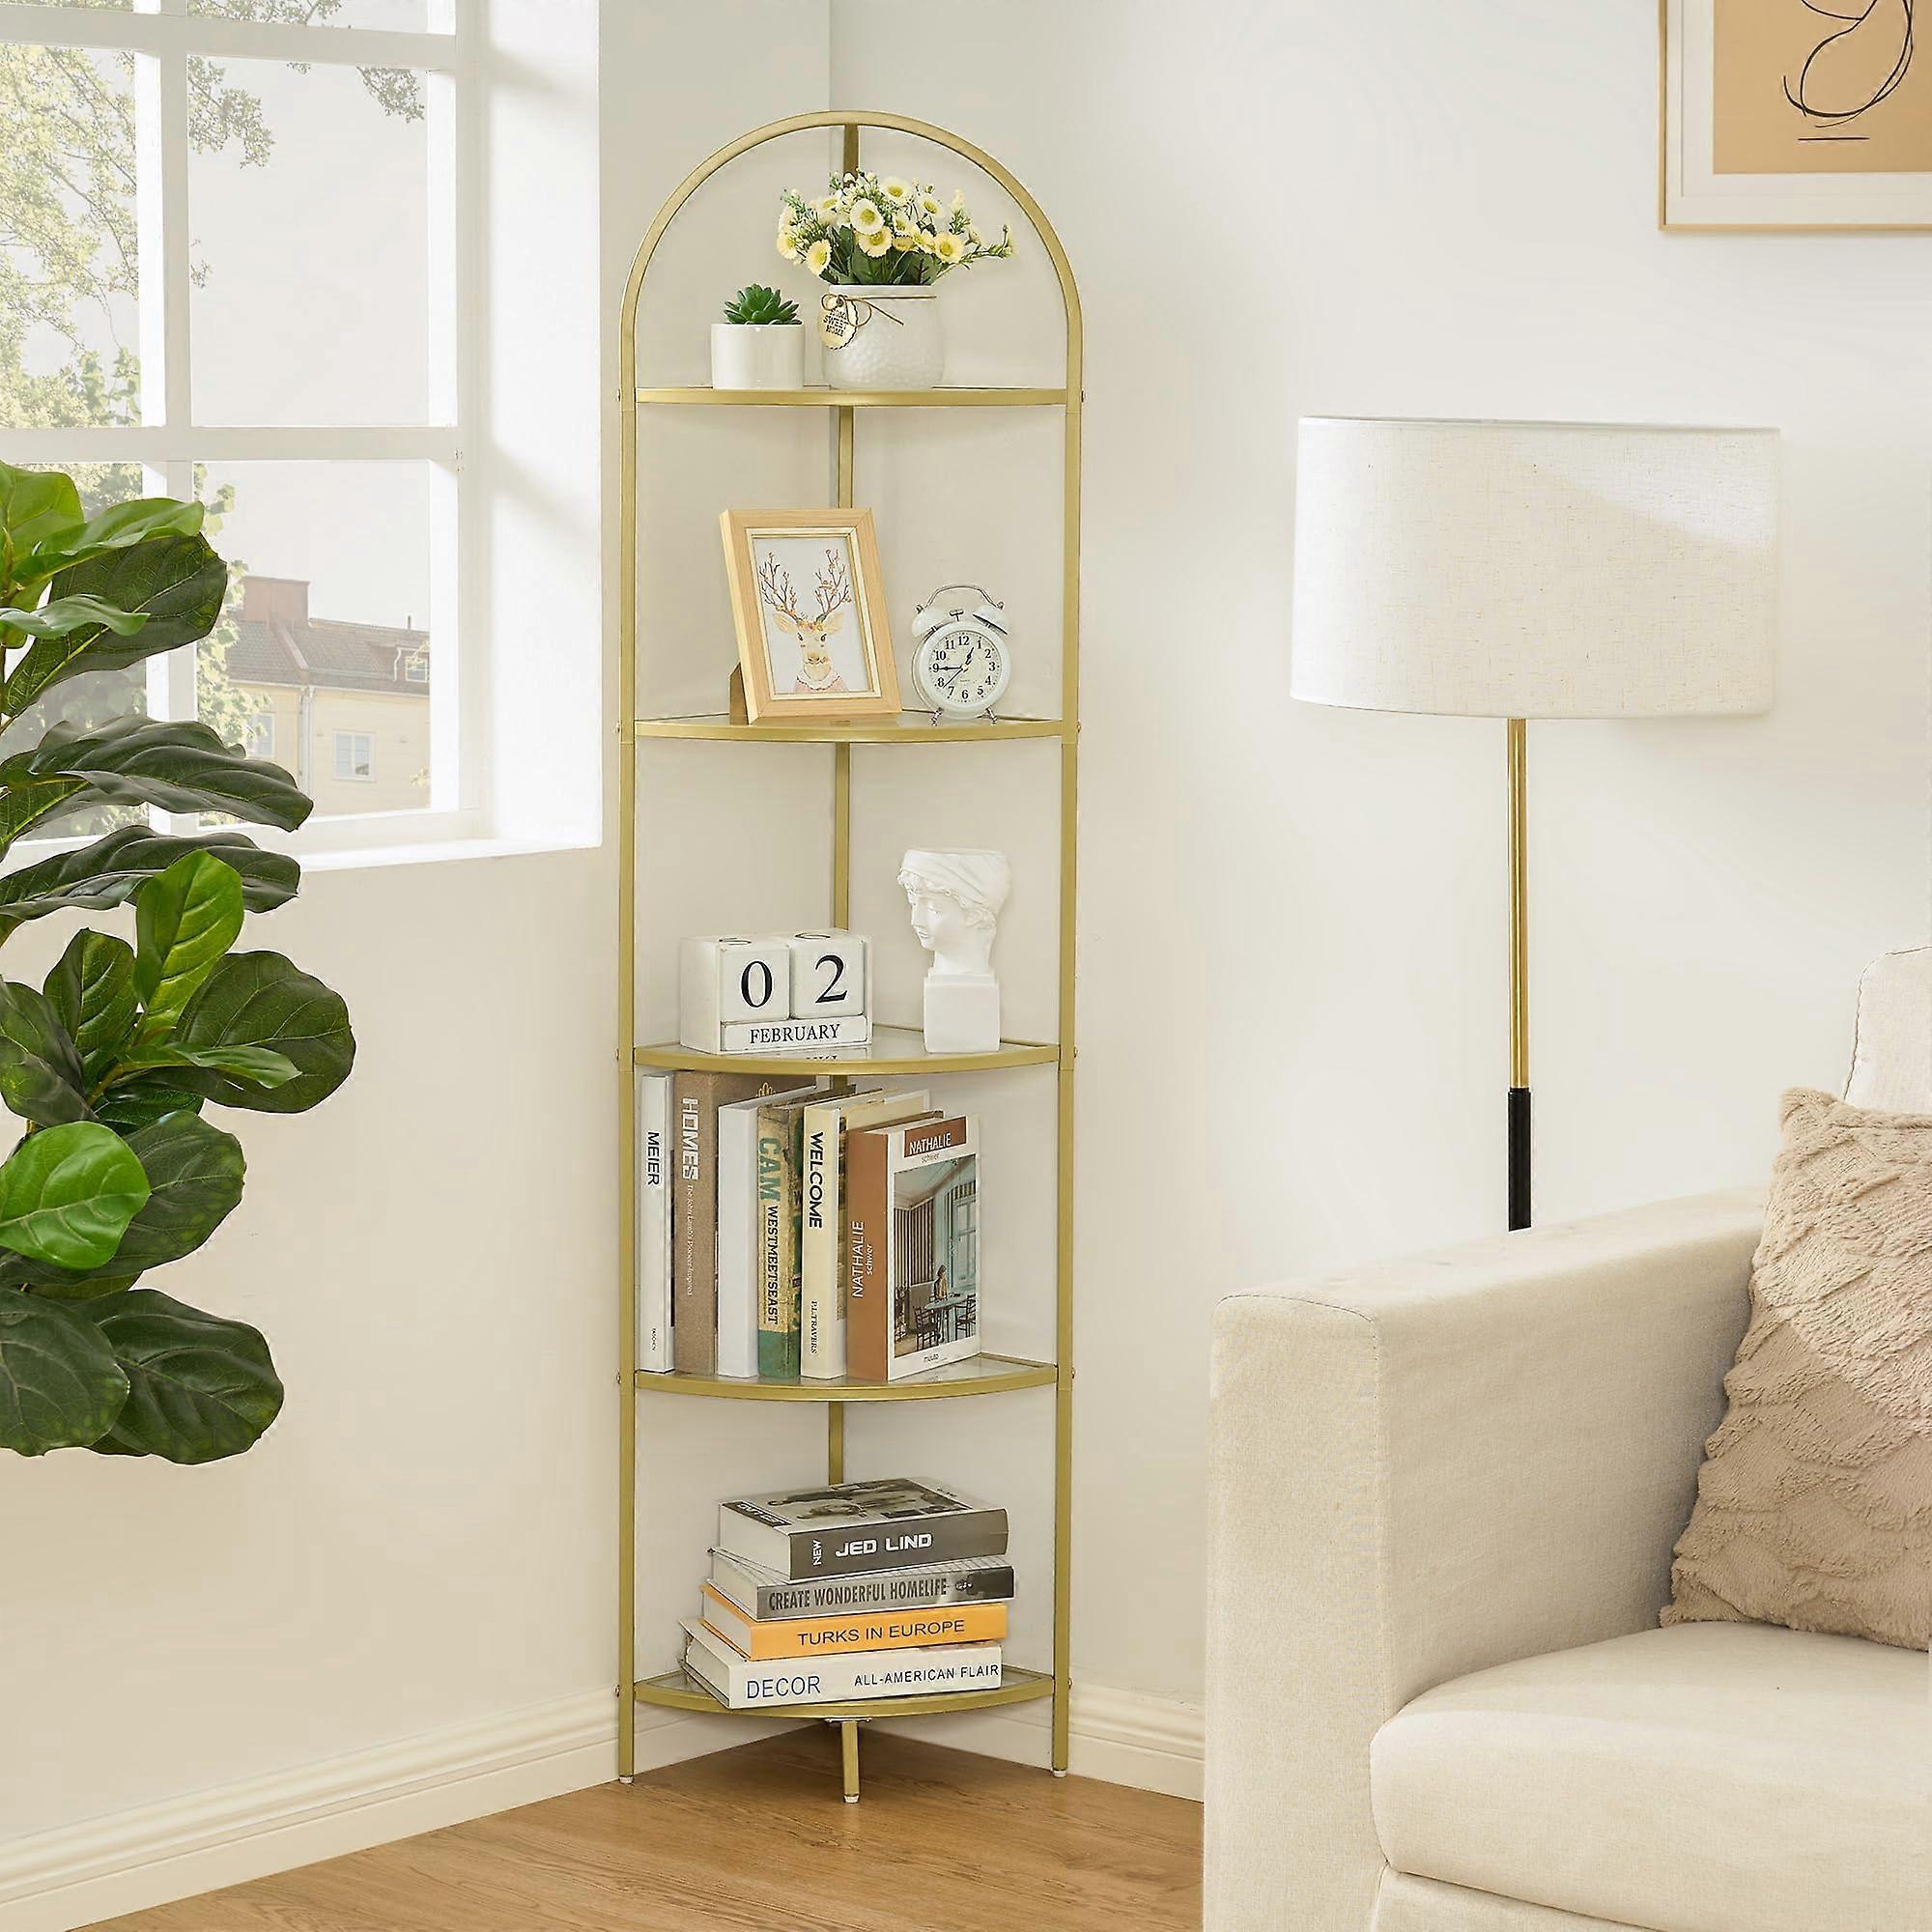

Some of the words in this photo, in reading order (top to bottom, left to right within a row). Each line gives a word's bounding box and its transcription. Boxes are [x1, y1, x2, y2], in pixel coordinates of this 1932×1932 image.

[945, 640, 955, 650] 11
[958, 636, 970, 645] 12
[977, 639, 982, 649] 1
[935, 651, 947, 661] 10
[984, 649, 991, 659] 2
[932, 663, 940, 673] 9
[988, 662, 996, 671] 3
[937, 677, 945, 688] 8
[948, 686, 954, 696] 7
[977, 686, 984, 696] 5
[984, 676, 992, 685] 4
[961, 690, 969, 699] 6
[750, 1023, 840, 1044] FEBRUARY
[682, 1097, 698, 1179] HOMES
[909, 1132, 952, 1155] NATHALIE
[647, 1131, 660, 1185] MEIER
[758, 1137, 781, 1202] CAM
[809, 1131, 824, 1229] WELCOME
[767, 1205, 779, 1325] WESTMEETSEAST
[851, 1220, 865, 1298] NATHALIE
[812, 1539, 822, 1566] NEW
[835, 1539, 877, 1557] JED
[885, 1533, 933, 1551] LIND
[768, 1590, 811, 1611] CREATE
[813, 1582, 887, 1606] WONDERFUL
[890, 1577, 948, 1601] HOMELIFE
[798, 1628, 860, 1646] TURKS
[865, 1626, 883, 1640] IN
[888, 1619, 965, 1638] EUROPE
[854, 1666, 955, 1687] ALL-AMERICAN
[959, 1663, 1000, 1678] FLAIR
[746, 1675, 821, 1699] DECOR
